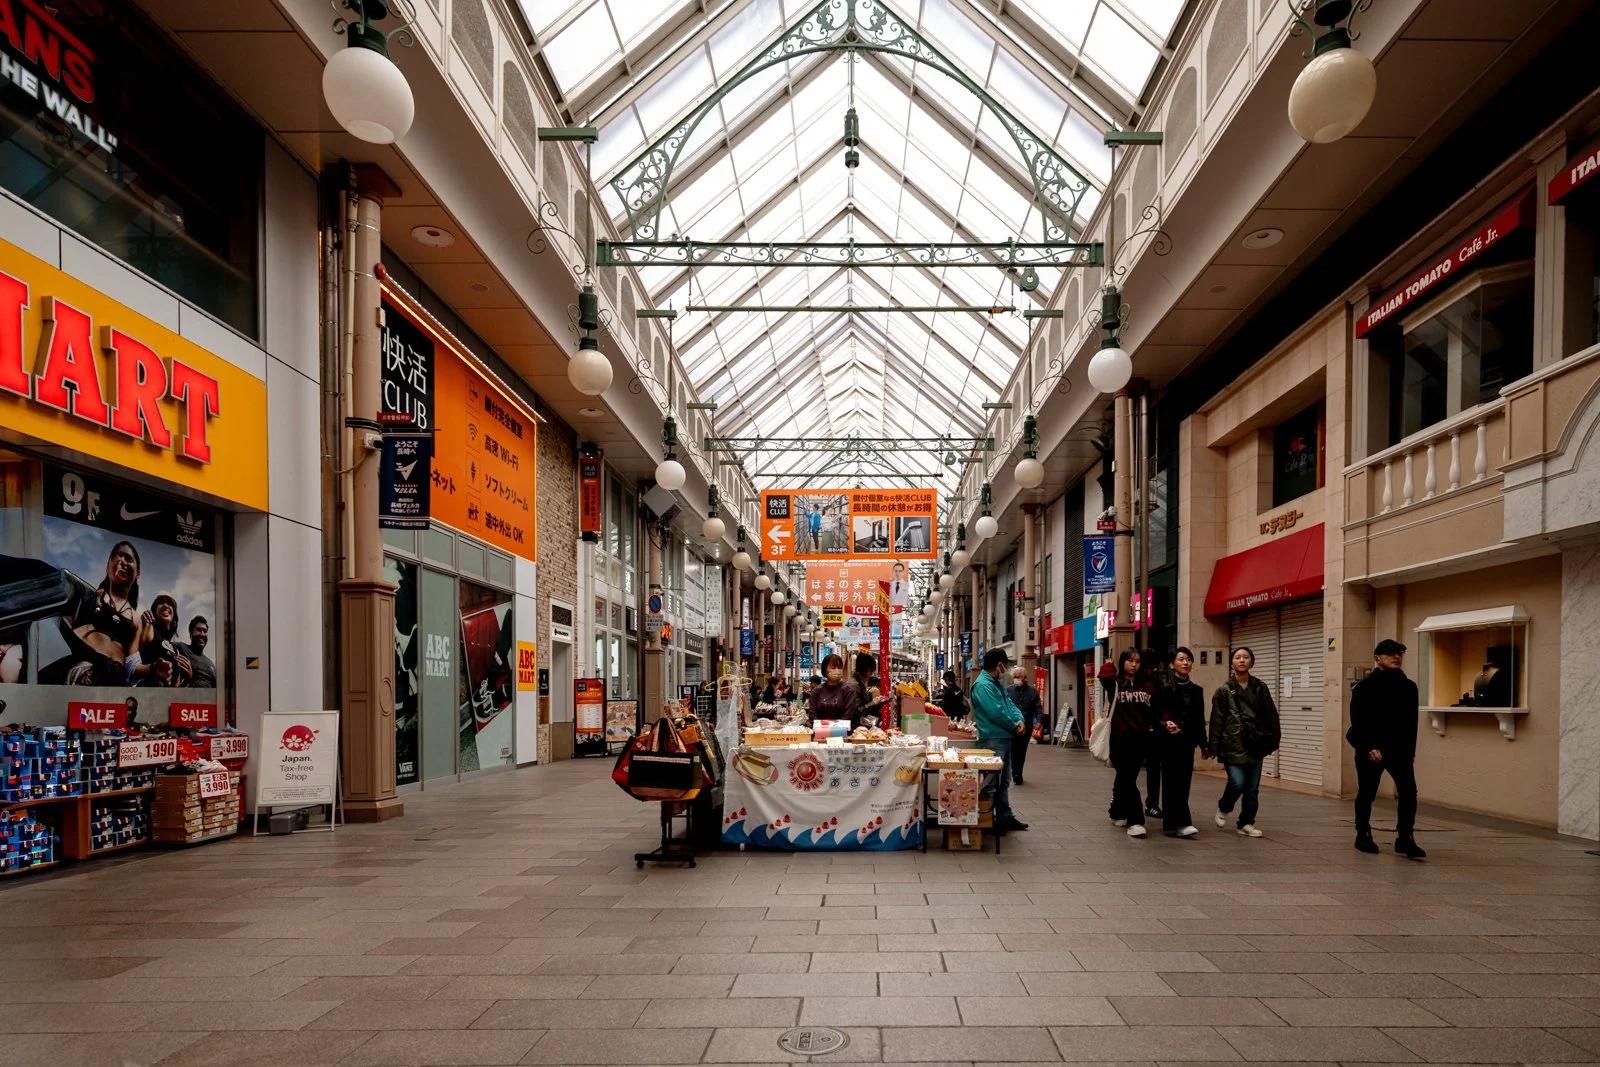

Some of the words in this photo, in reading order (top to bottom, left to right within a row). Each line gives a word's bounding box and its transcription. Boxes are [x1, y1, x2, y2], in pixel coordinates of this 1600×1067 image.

[1367, 292, 1403, 327] ITALIAN
[1405, 259, 1452, 300] TOMATO
[1458, 237, 1483, 262] Café
[1485, 228, 1499, 244] Jr.
[383, 326, 427, 395] 快活
[384, 380, 427, 430] CLUB
[394, 440, 419, 448] ようこそ
[484, 434, 499, 458] 高速
[500, 445, 519, 472] Wi-Fi
[485, 473, 529, 512] ソフトクリーム
[769, 498, 787, 508] 快活
[853, 503, 932, 512] 長時間の休憩がお得
[176, 534, 203, 547] adidas
[512, 527, 524, 544] OK
[770, 545, 787, 556] 3F
[811, 579, 876, 589] はまのまち
[824, 591, 877, 602] 整形外科
[1226, 598, 1245, 609] ITALIAN
[1246, 592, 1269, 605] TOMATO
[851, 605, 870, 614] Tax
[426, 633, 450, 660] ABC
[518, 649, 535, 670] ABC
[426, 660, 450, 677] MART
[518, 670, 535, 683] MART
[80, 708, 115, 724] ALE
[180, 708, 209, 722] SALE
[120, 746, 138, 754] GOOD
[120, 753, 138, 762] PRICE!
[281, 755, 313, 764] Japan.
[280, 764, 314, 772] Tax-free
[399, 761, 414, 774] VANS
[828, 765, 884, 774] ワークショップ
[285, 773, 308, 781] Shop
[830, 777, 880, 787] あさひ
